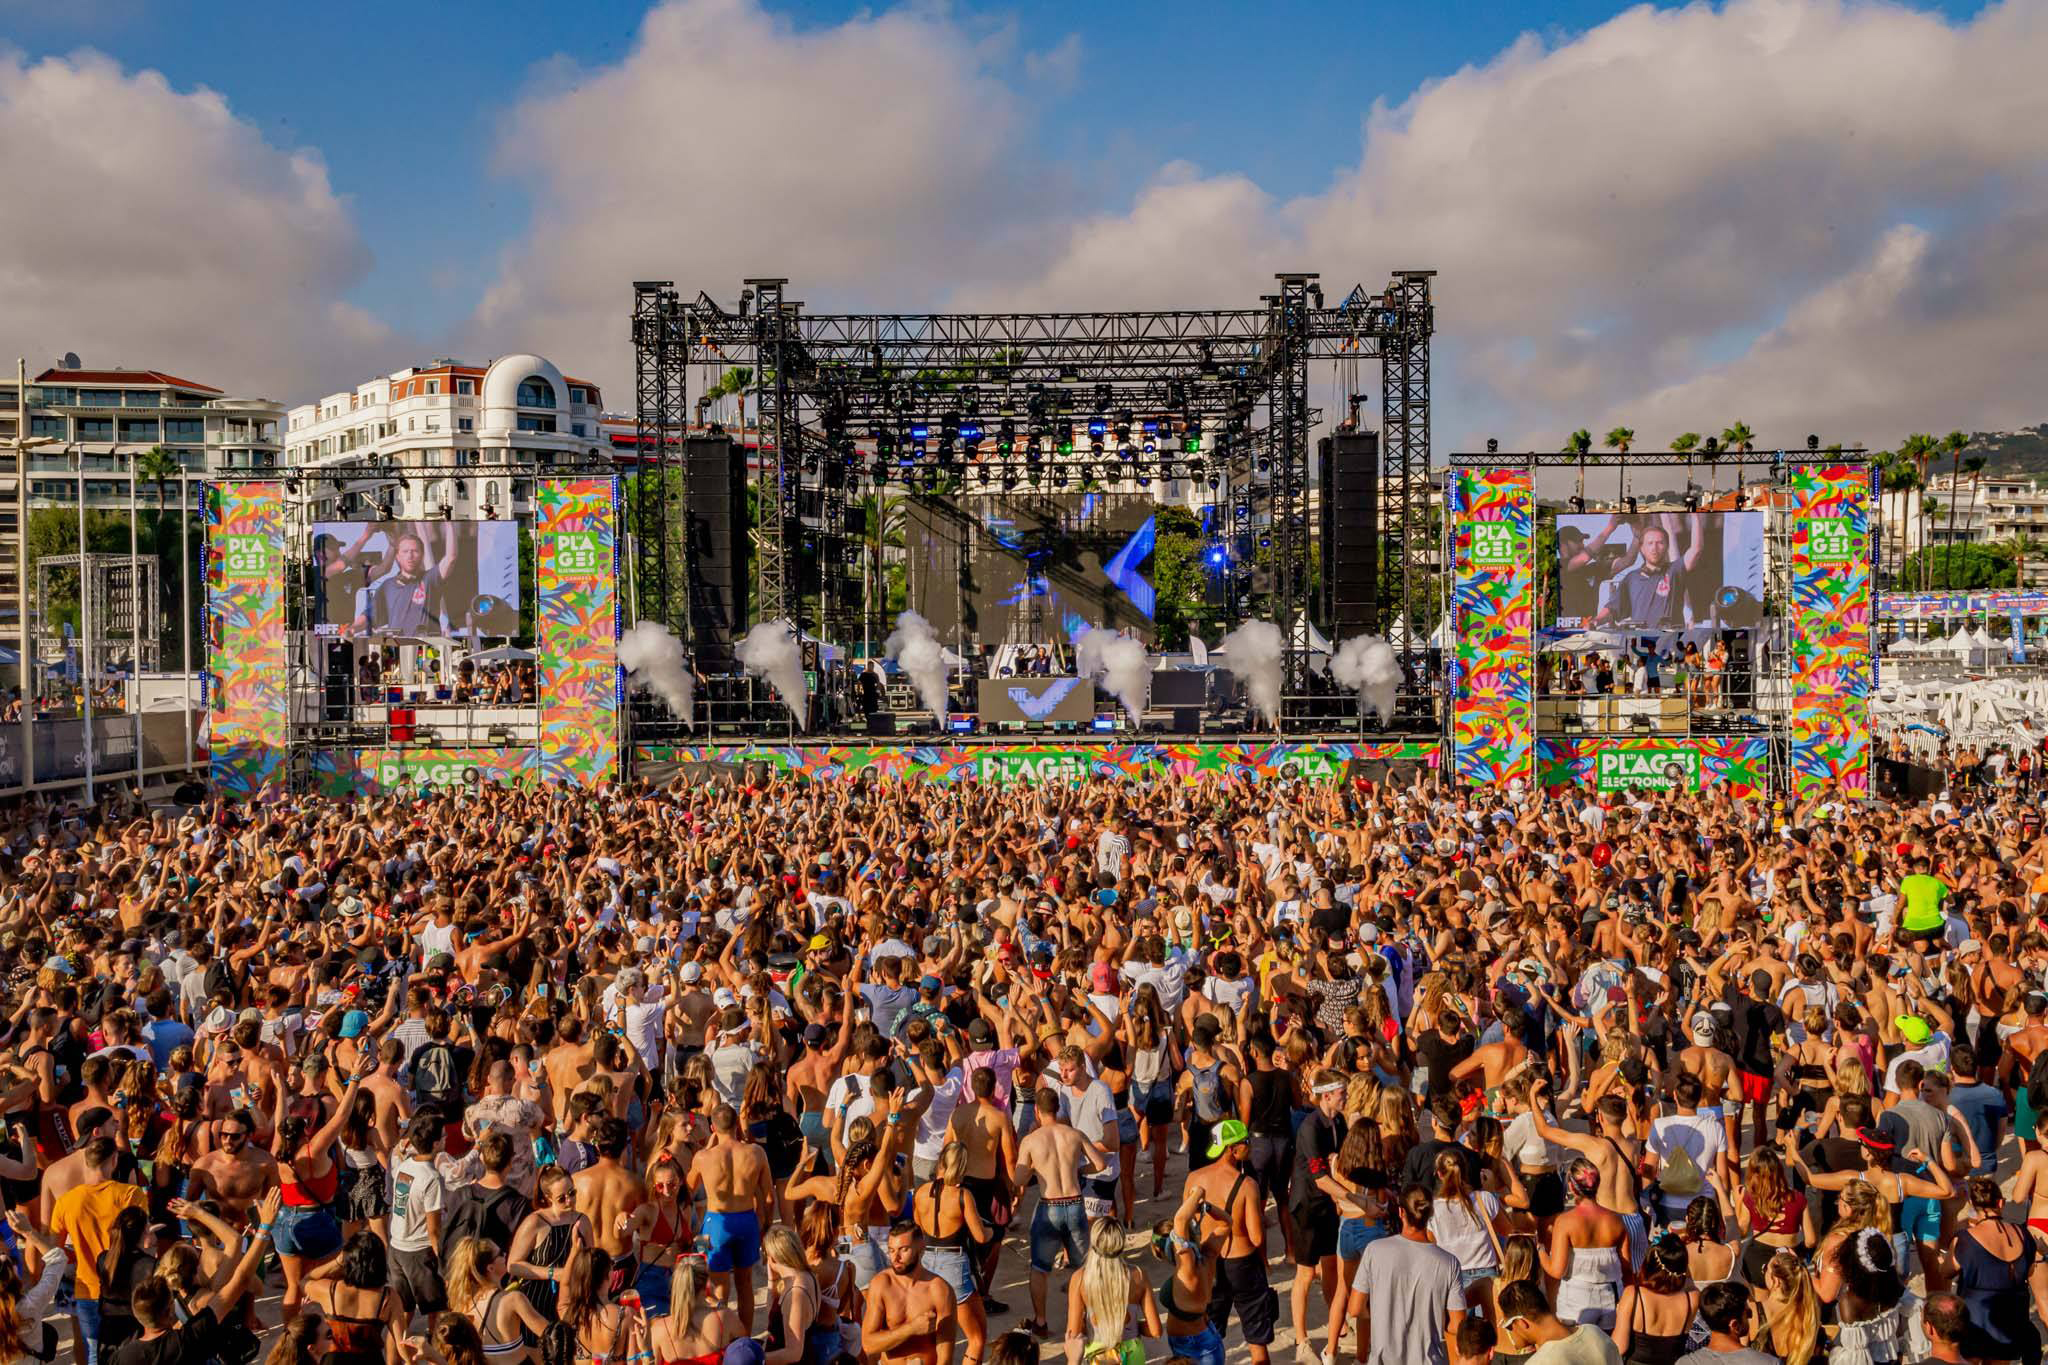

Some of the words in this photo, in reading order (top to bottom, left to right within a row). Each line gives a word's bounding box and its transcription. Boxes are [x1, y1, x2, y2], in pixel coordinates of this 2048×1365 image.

[1475, 525, 1512, 540] PLA
[1812, 522, 1848, 536] PLA
[230, 538, 265, 552] PLA
[558, 536, 594, 550] PLA
[1476, 542, 1512, 556] GES
[1813, 538, 1848, 553] GES
[230, 555, 265, 569] GES
[559, 552, 594, 567] GES
[384, 764, 477, 785] PAGE
[1602, 776, 1695, 788] ELECTRONIS
